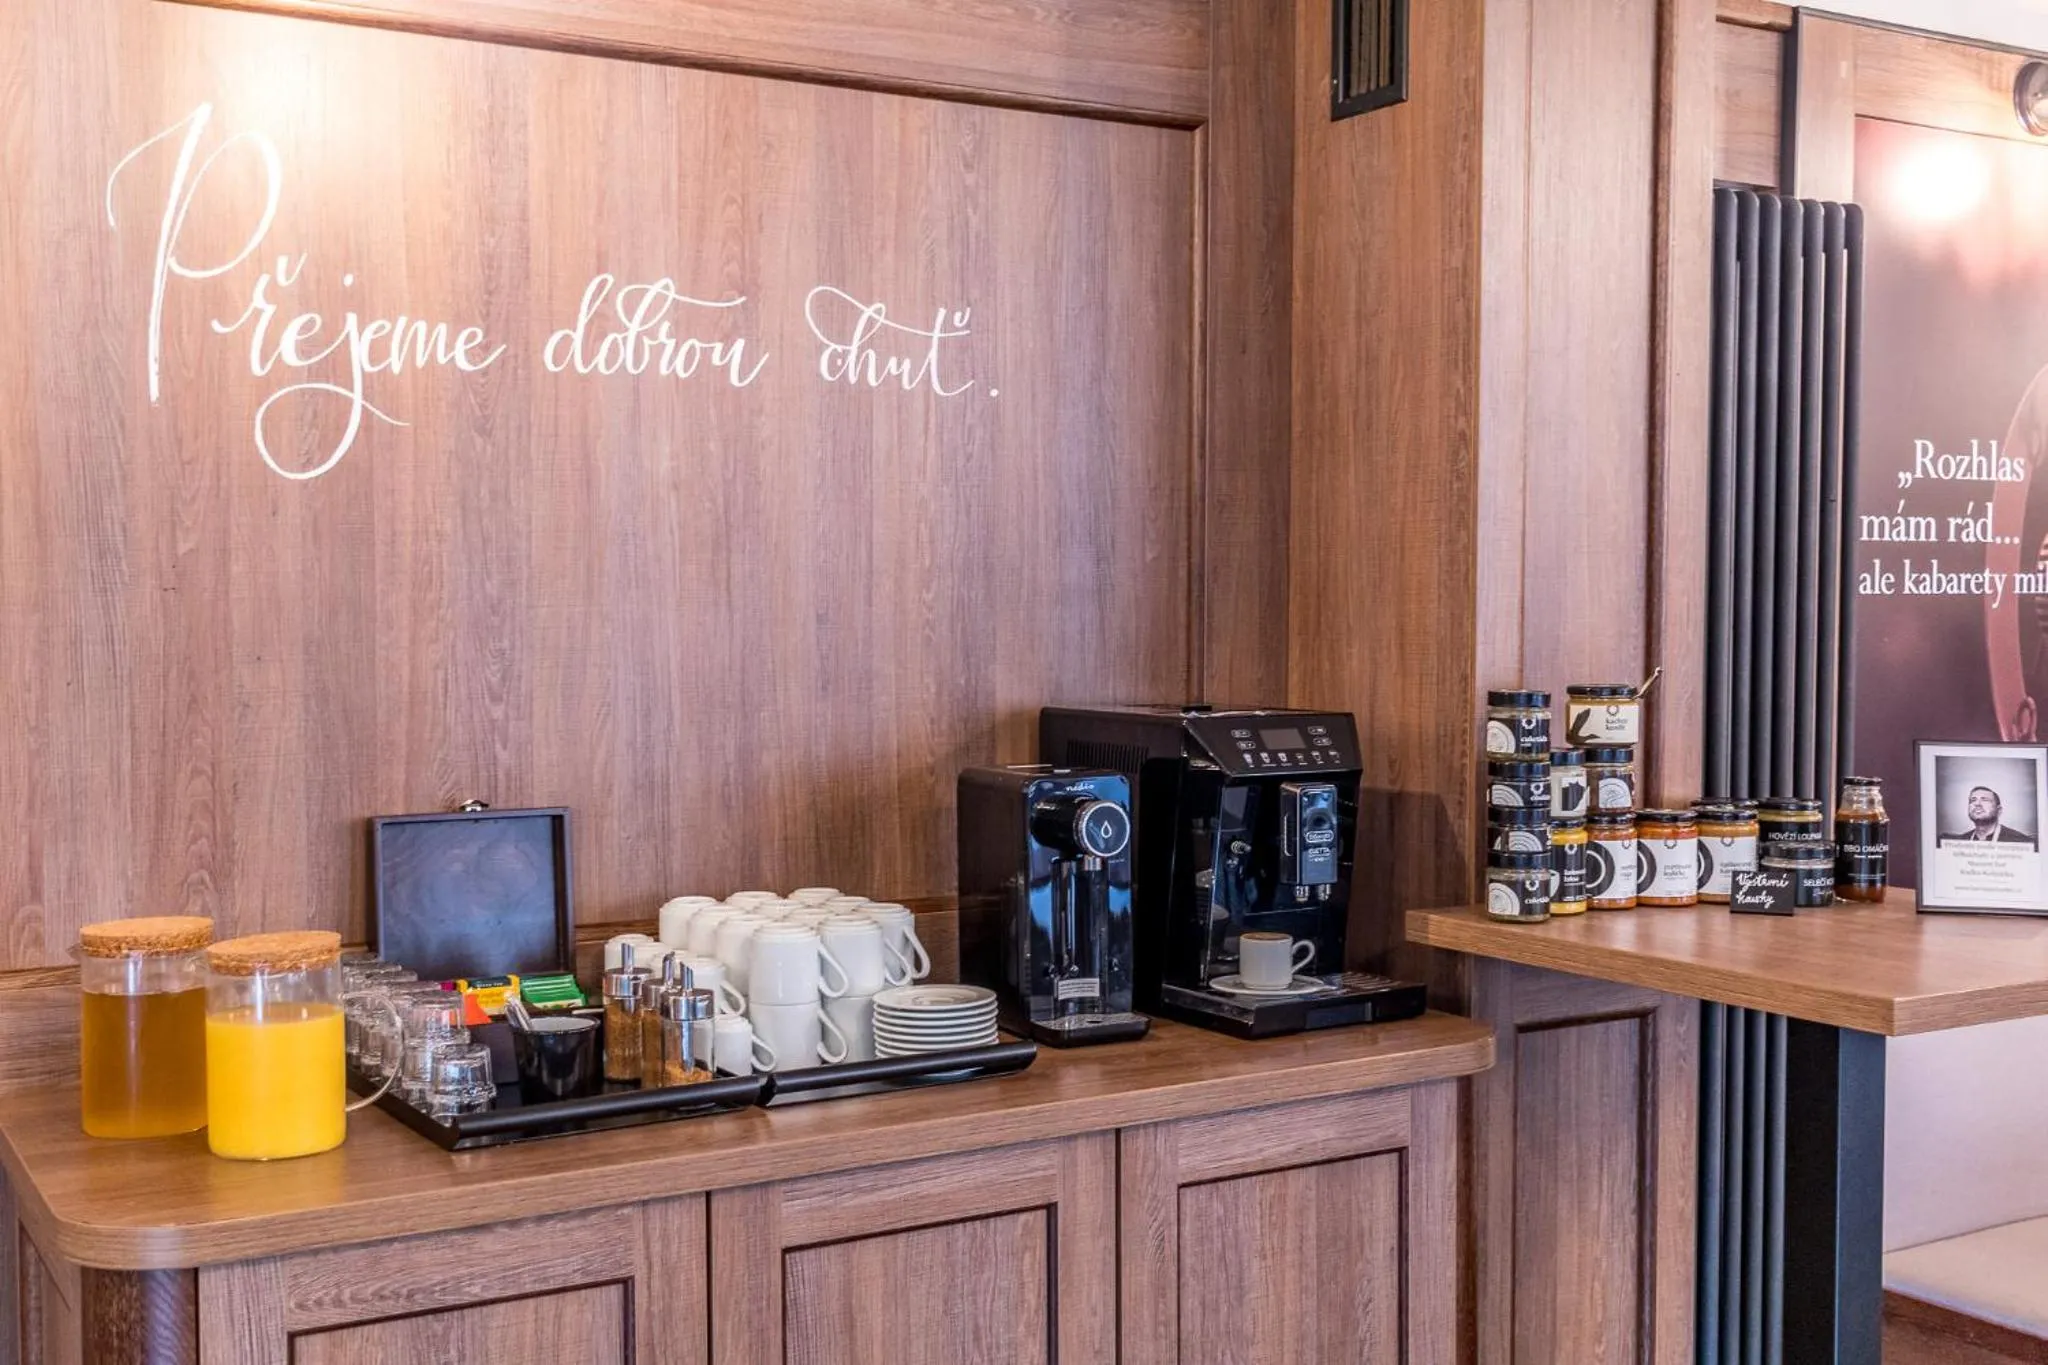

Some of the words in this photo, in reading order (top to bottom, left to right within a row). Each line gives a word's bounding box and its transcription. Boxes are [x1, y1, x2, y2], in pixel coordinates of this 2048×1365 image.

[106, 102, 506, 480] Přejeme
[543, 273, 769, 387] dobrou
[1859, 498, 1938, 542] mám
[1947, 501, 2020, 545] rád...
[1859, 559, 1895, 595] ale
[1903, 559, 2007, 609] kabarety
